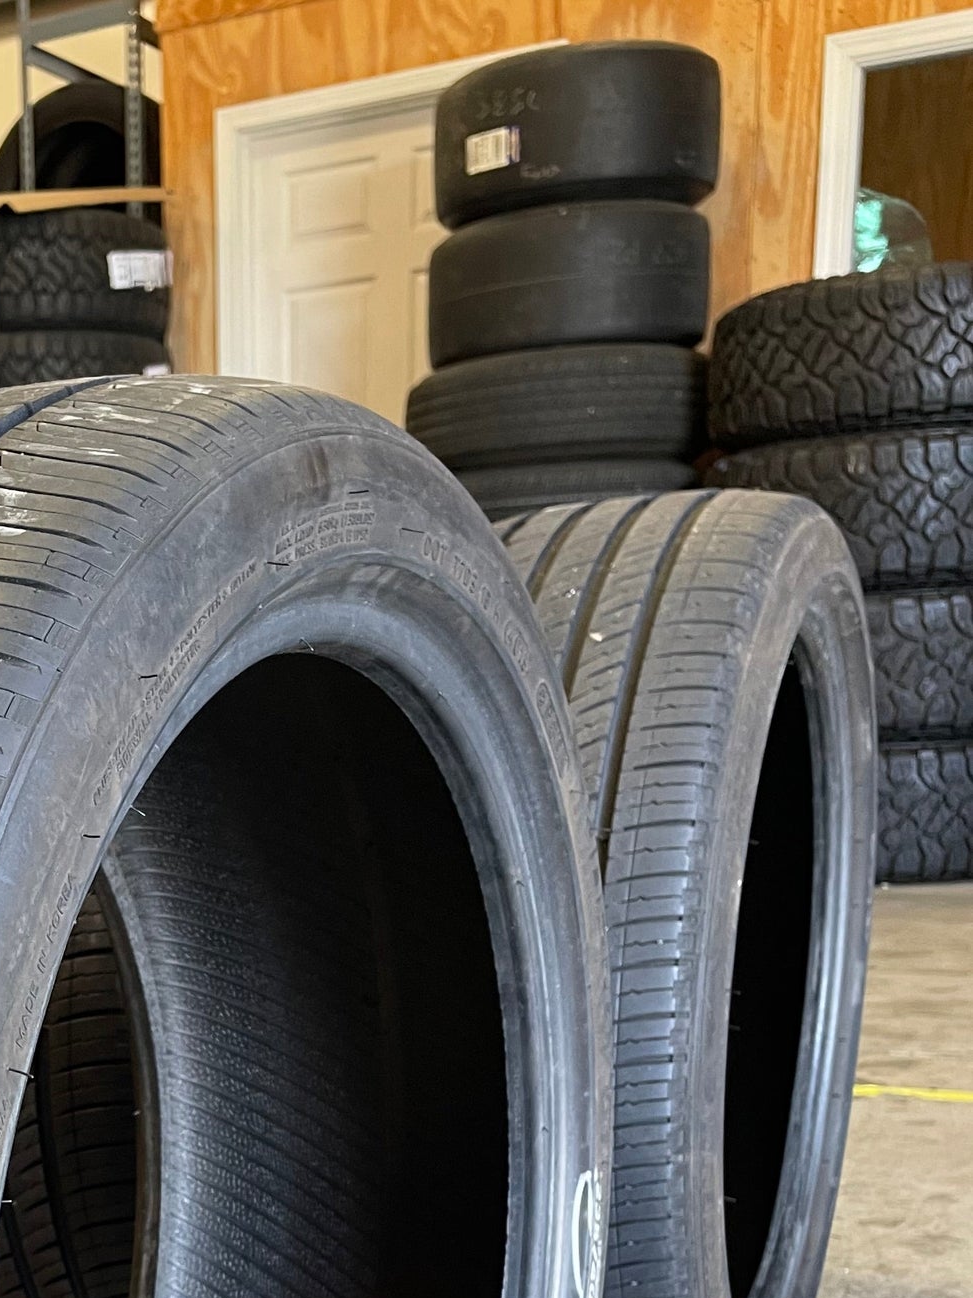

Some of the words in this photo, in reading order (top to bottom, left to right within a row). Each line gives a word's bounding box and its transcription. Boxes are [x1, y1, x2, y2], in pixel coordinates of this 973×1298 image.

[15, 981, 40, 1050] MADE
[35, 944, 51, 975] IN
[45, 872, 79, 946] KOREA
